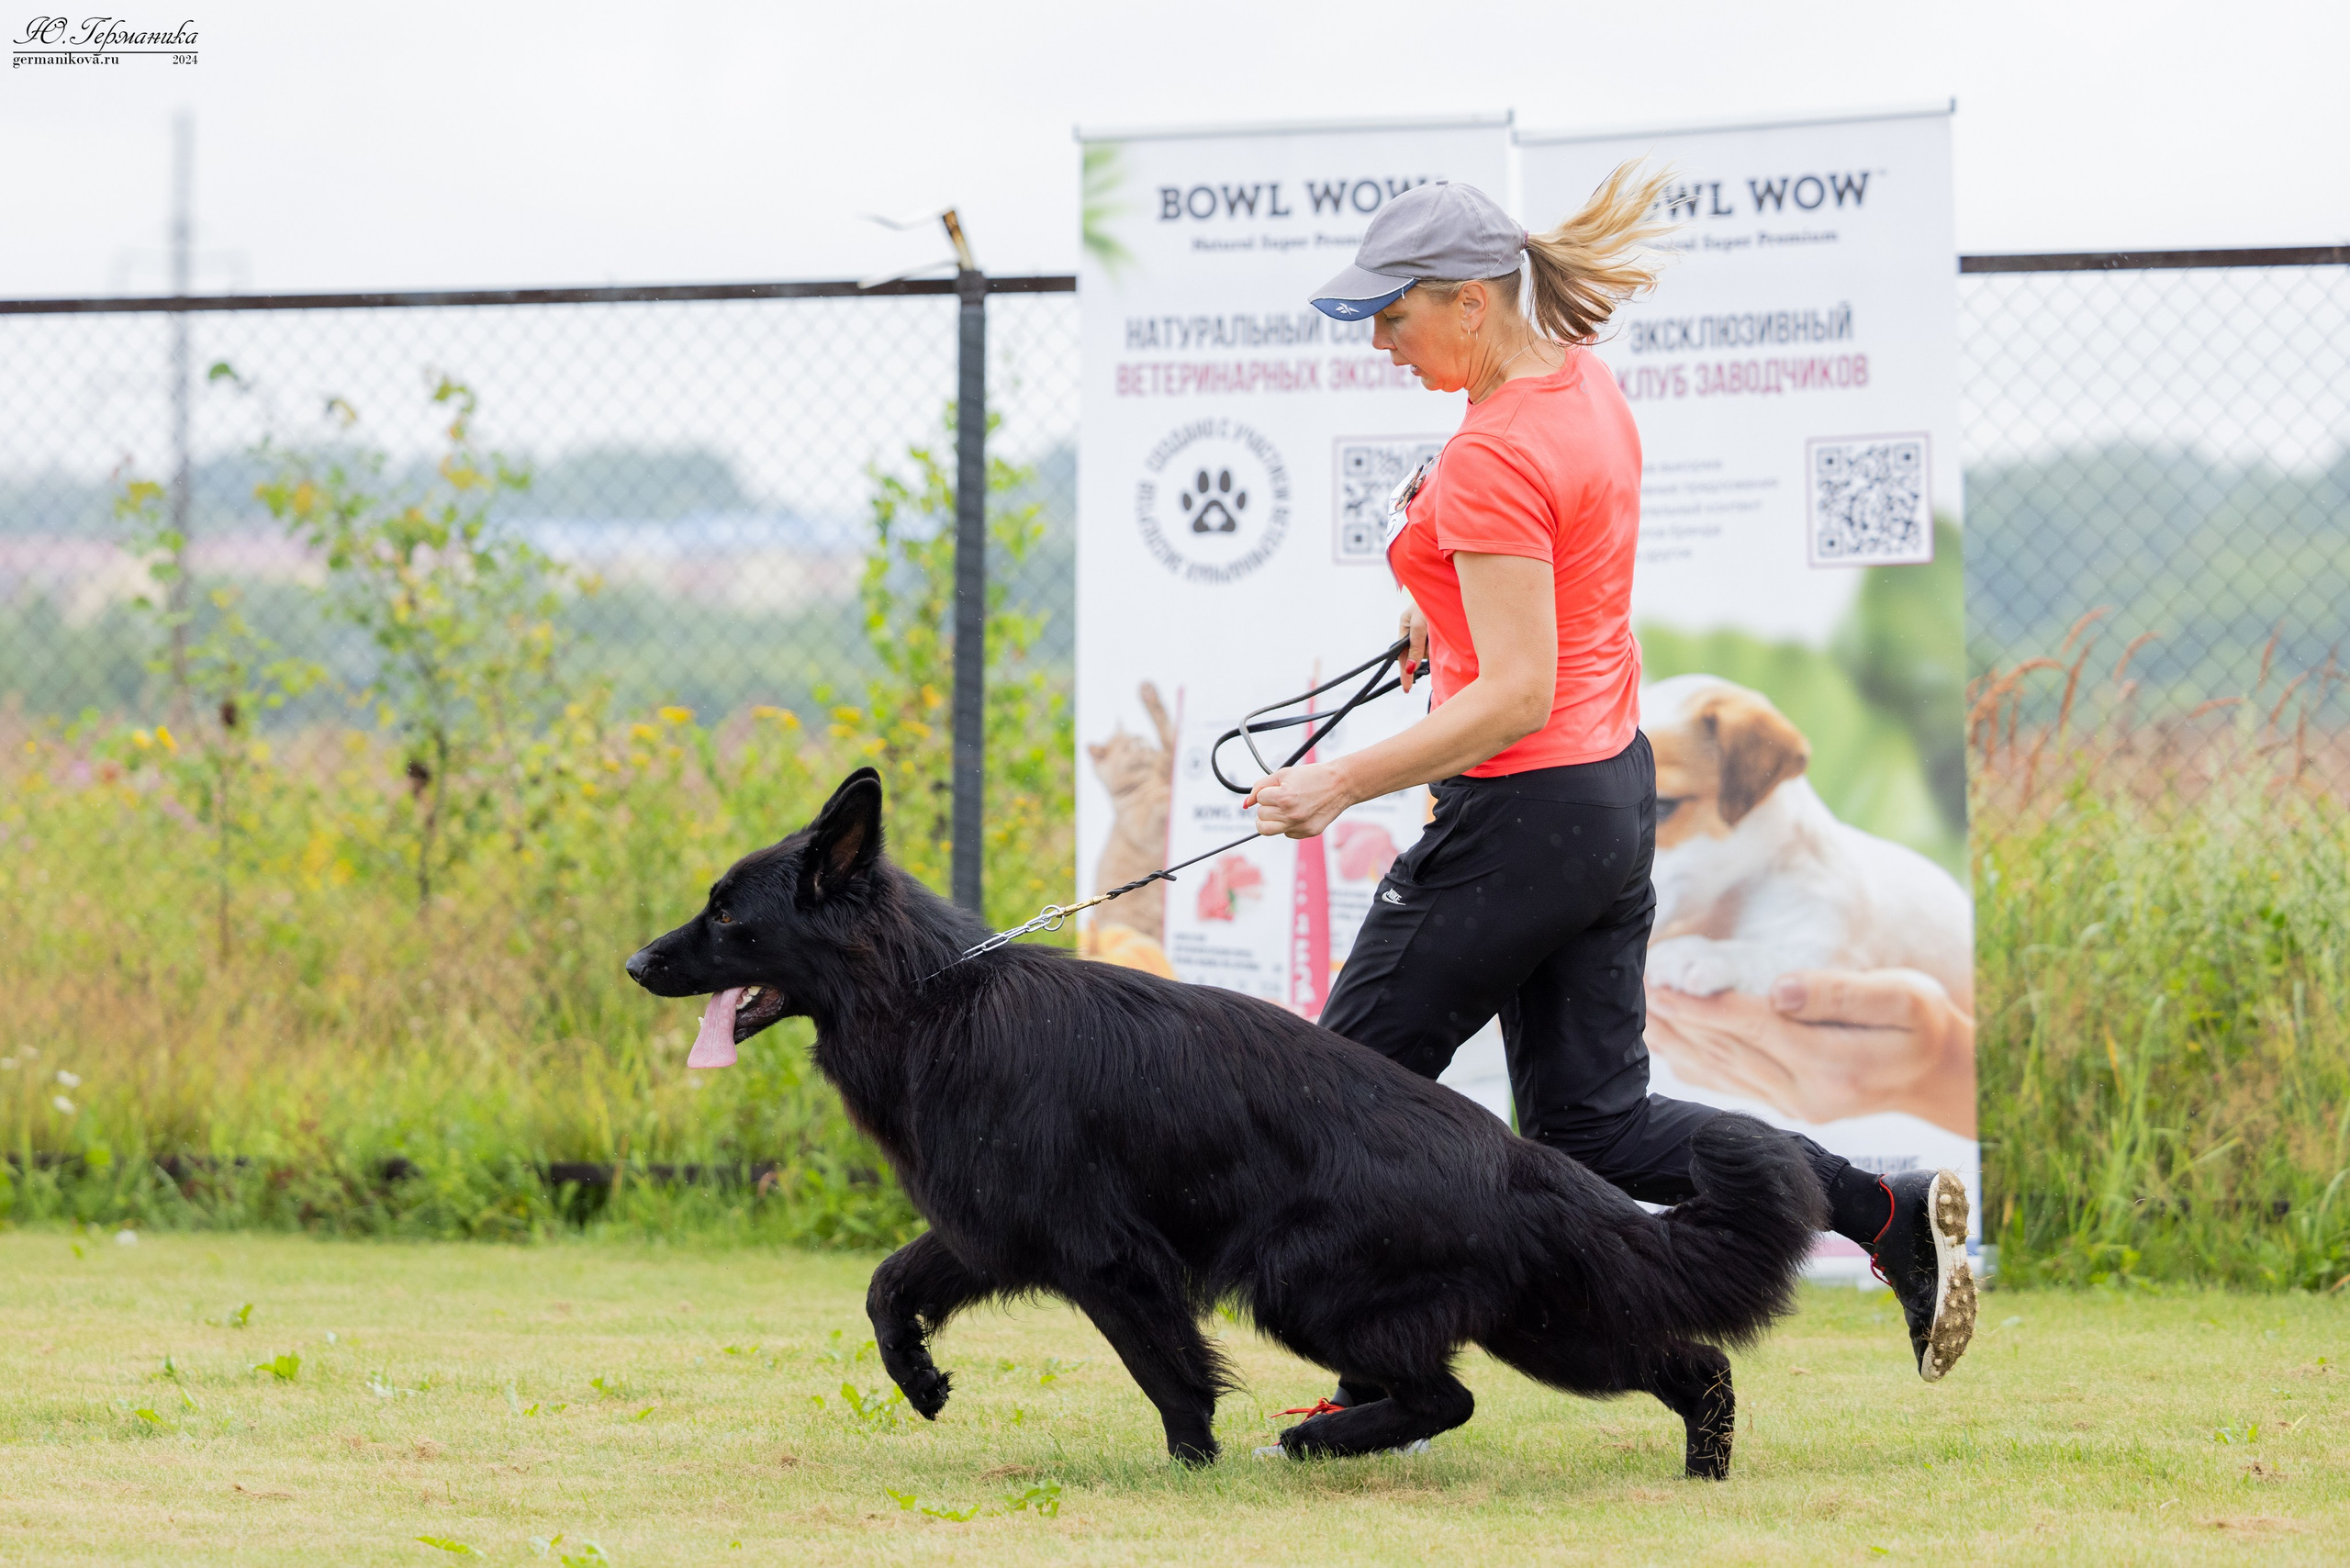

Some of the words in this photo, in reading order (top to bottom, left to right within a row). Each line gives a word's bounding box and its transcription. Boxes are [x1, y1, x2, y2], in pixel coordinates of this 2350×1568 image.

[1159, 185, 1291, 219] BOWL
[1747, 172, 1870, 212] WOW
[1758, 229, 1838, 246] Premium
[1125, 313, 1322, 349] НАТУРАЛЬНЫЙ
[1630, 302, 1852, 353] ЭКСКЛЮЗИВНЫЙ
[1116, 359, 1320, 397] ВЕТЕРИНАРНЫХ
[1617, 364, 1687, 400] КЛУБ
[1695, 353, 1870, 397] ЗАВОДЧИКОВ
